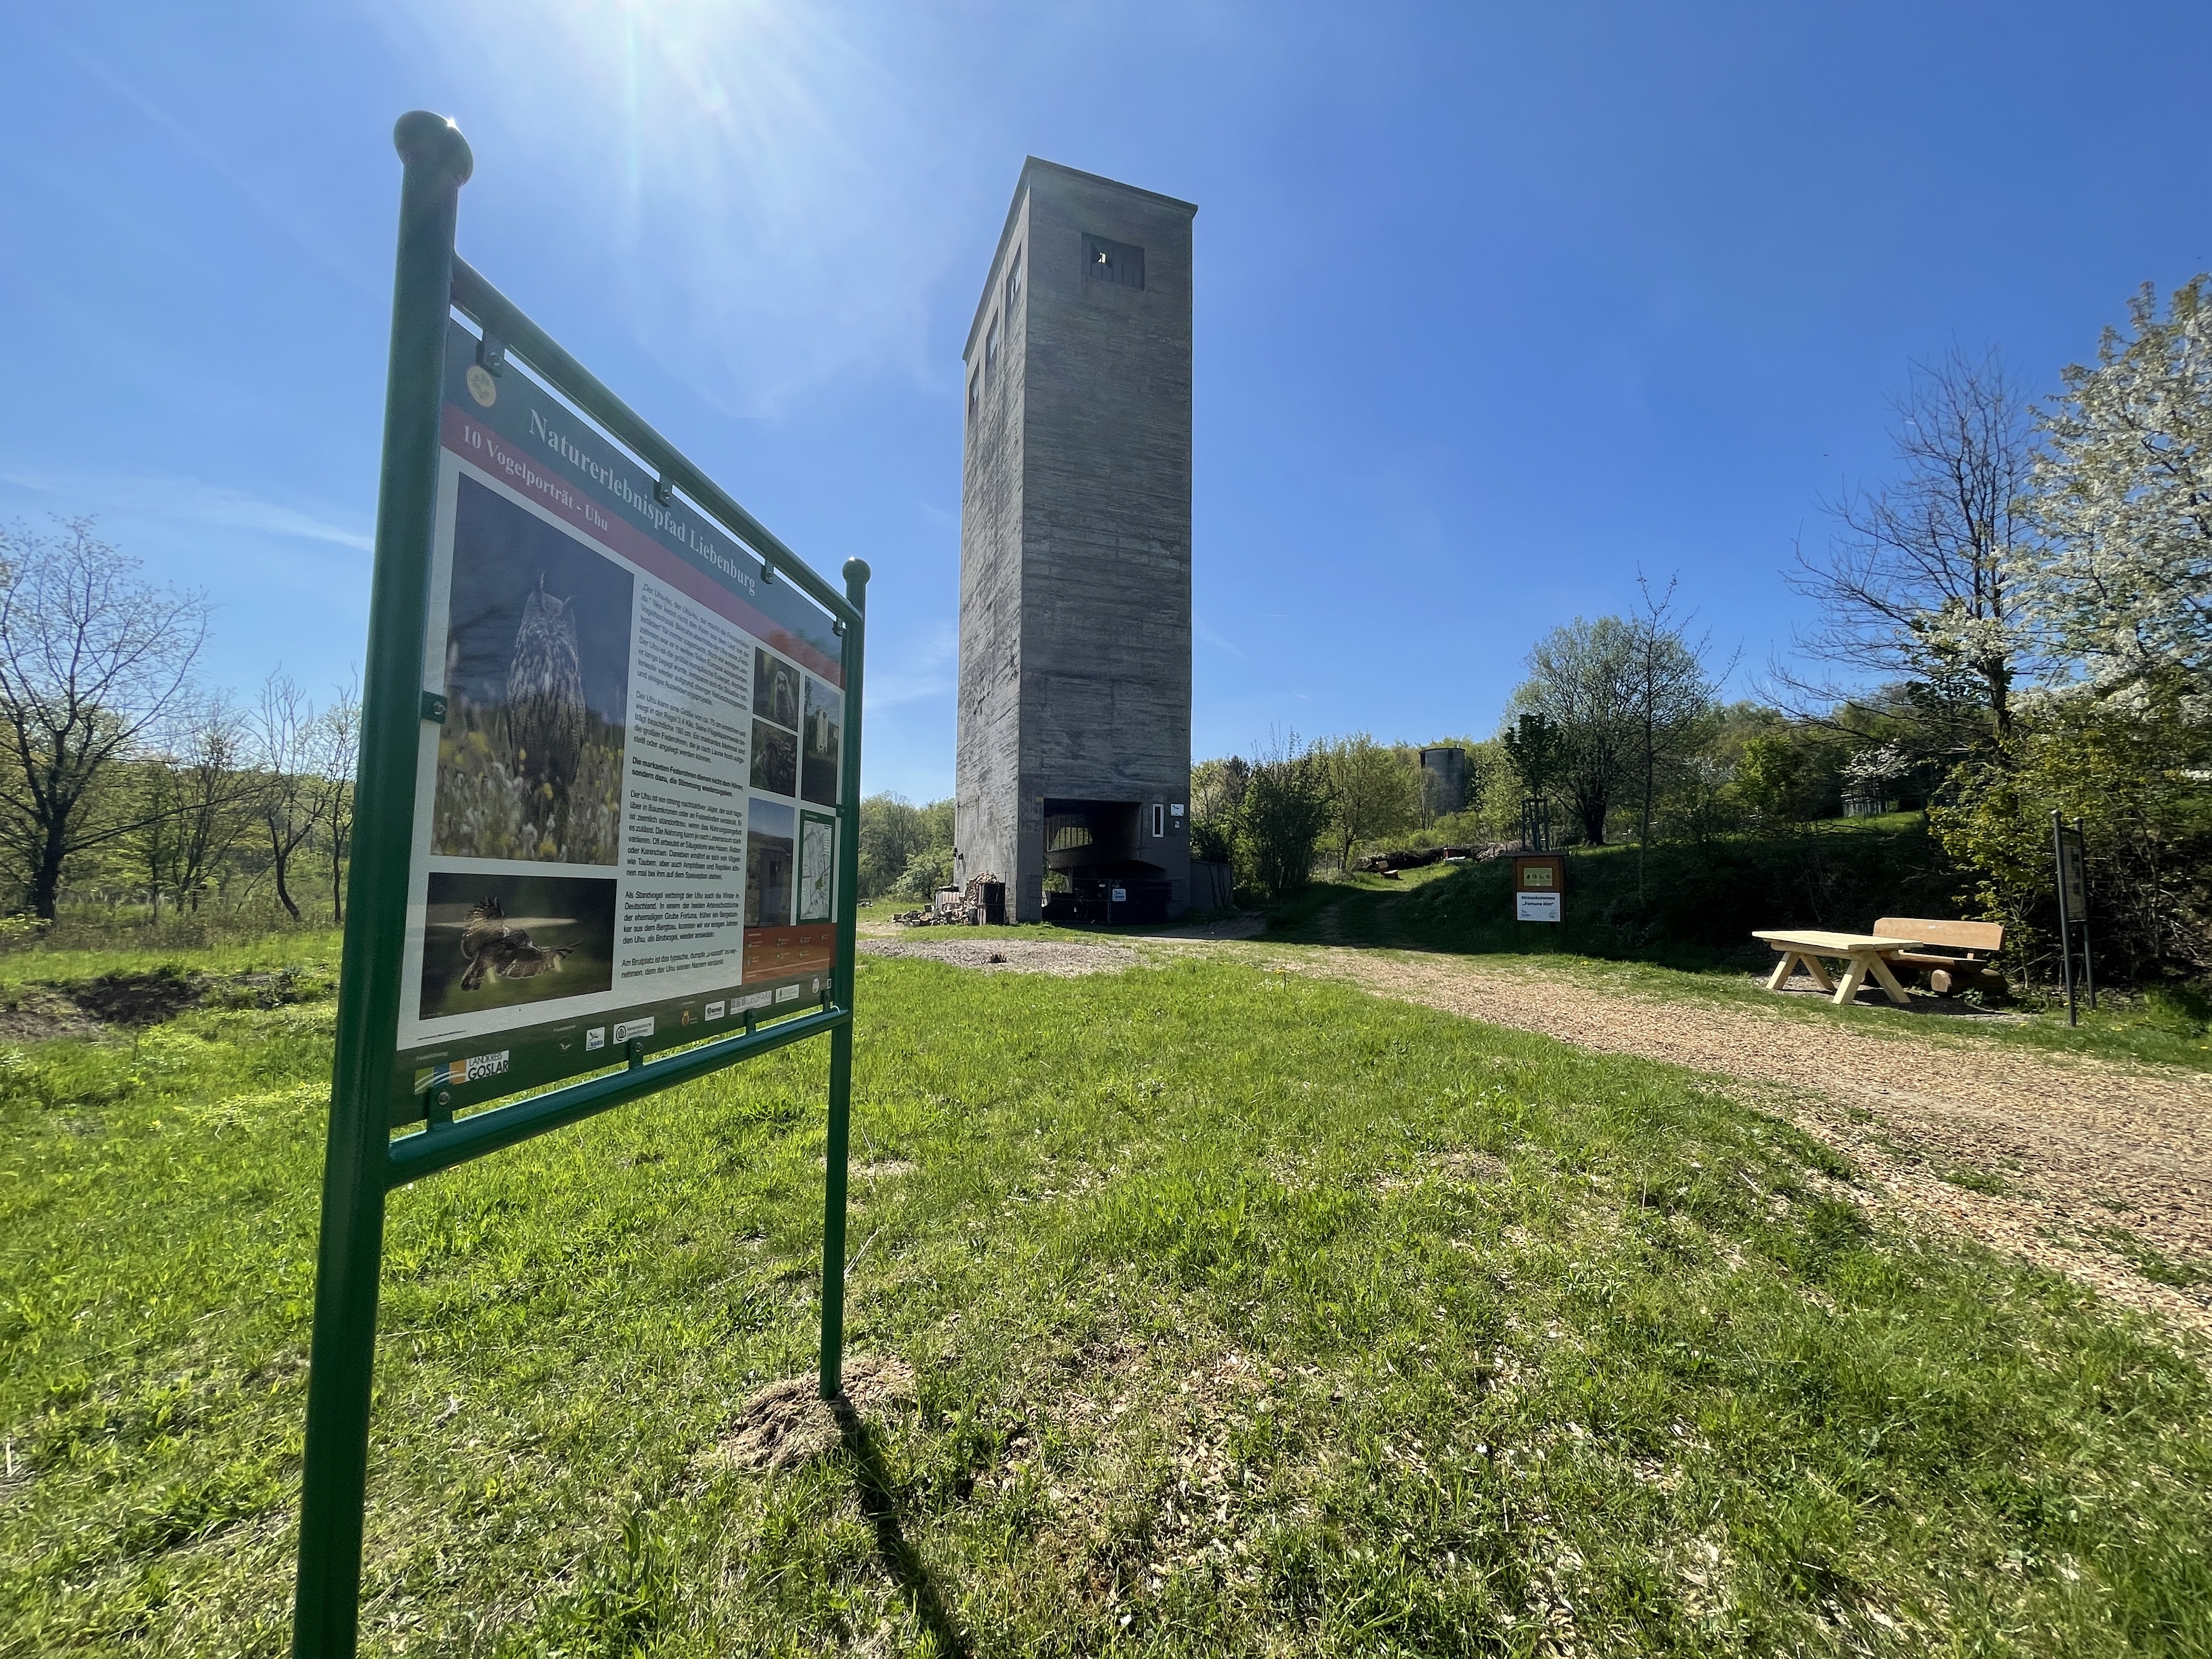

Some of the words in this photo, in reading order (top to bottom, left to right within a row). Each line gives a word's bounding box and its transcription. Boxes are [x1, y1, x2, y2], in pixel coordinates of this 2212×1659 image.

[462, 425, 481, 449] 10
[487, 438, 573, 509] Vogelporträt
[585, 504, 608, 531] Uhu
[529, 408, 685, 543] Naturerlebnispfad
[690, 528, 755, 596] Liebenburg
[636, 691, 646, 700] Der
[647, 695, 657, 704] Uhu
[633, 757, 642, 765] Die
[632, 769, 654, 778] sondern
[641, 792, 652, 800] Uhu
[469, 1052, 503, 1066] LANDKREIS
[468, 1060, 509, 1080] GOSLAR
